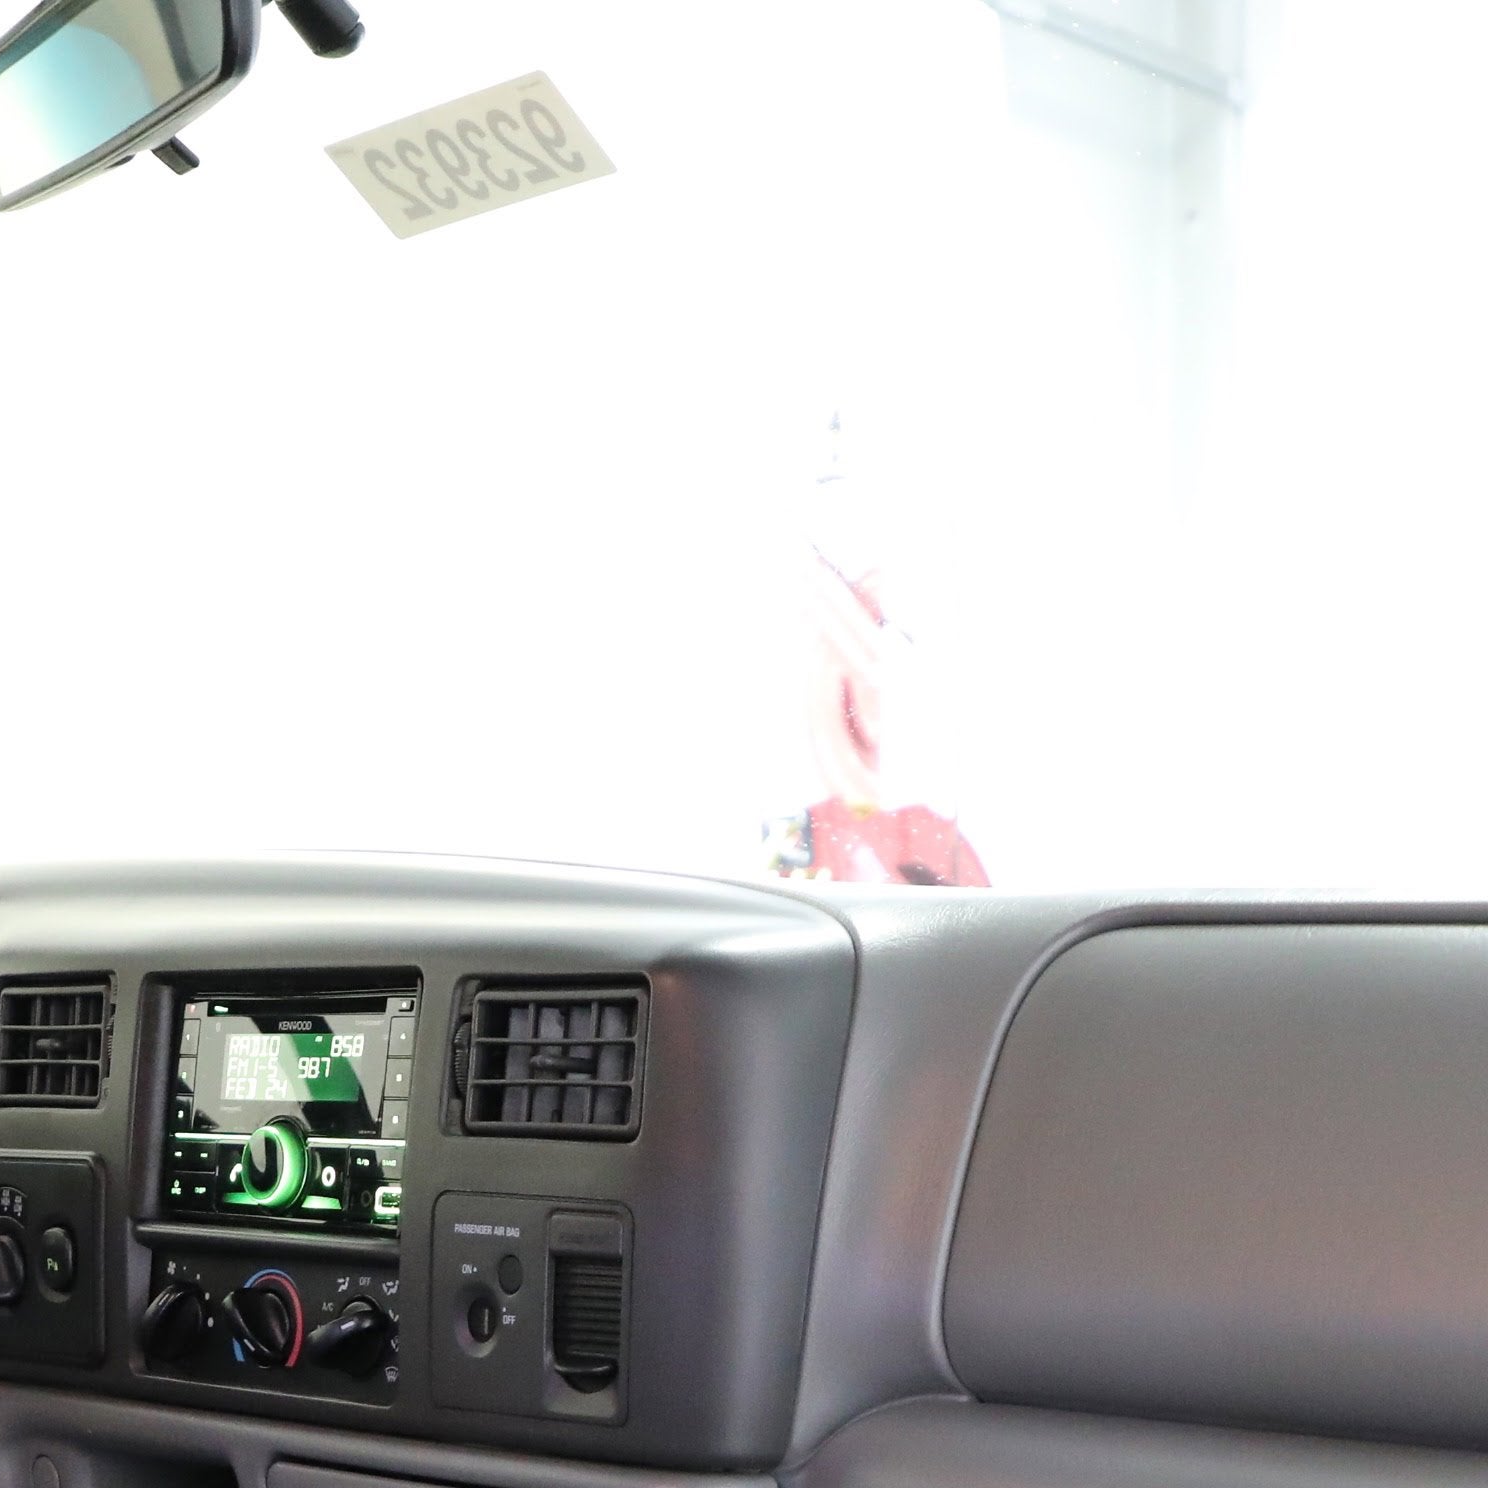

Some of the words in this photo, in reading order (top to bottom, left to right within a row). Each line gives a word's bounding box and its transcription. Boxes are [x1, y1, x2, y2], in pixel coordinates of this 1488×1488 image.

[278, 1020, 312, 1031] KENWOOD
[228, 1035, 281, 1057] RADIO
[454, 1223, 492, 1235] PASSENGER
[493, 1225, 505, 1236] AIR
[506, 1226, 520, 1237] BAG
[462, 1263, 472, 1274] ON
[358, 1276, 372, 1286] OFF
[502, 1314, 517, 1325] OFF
